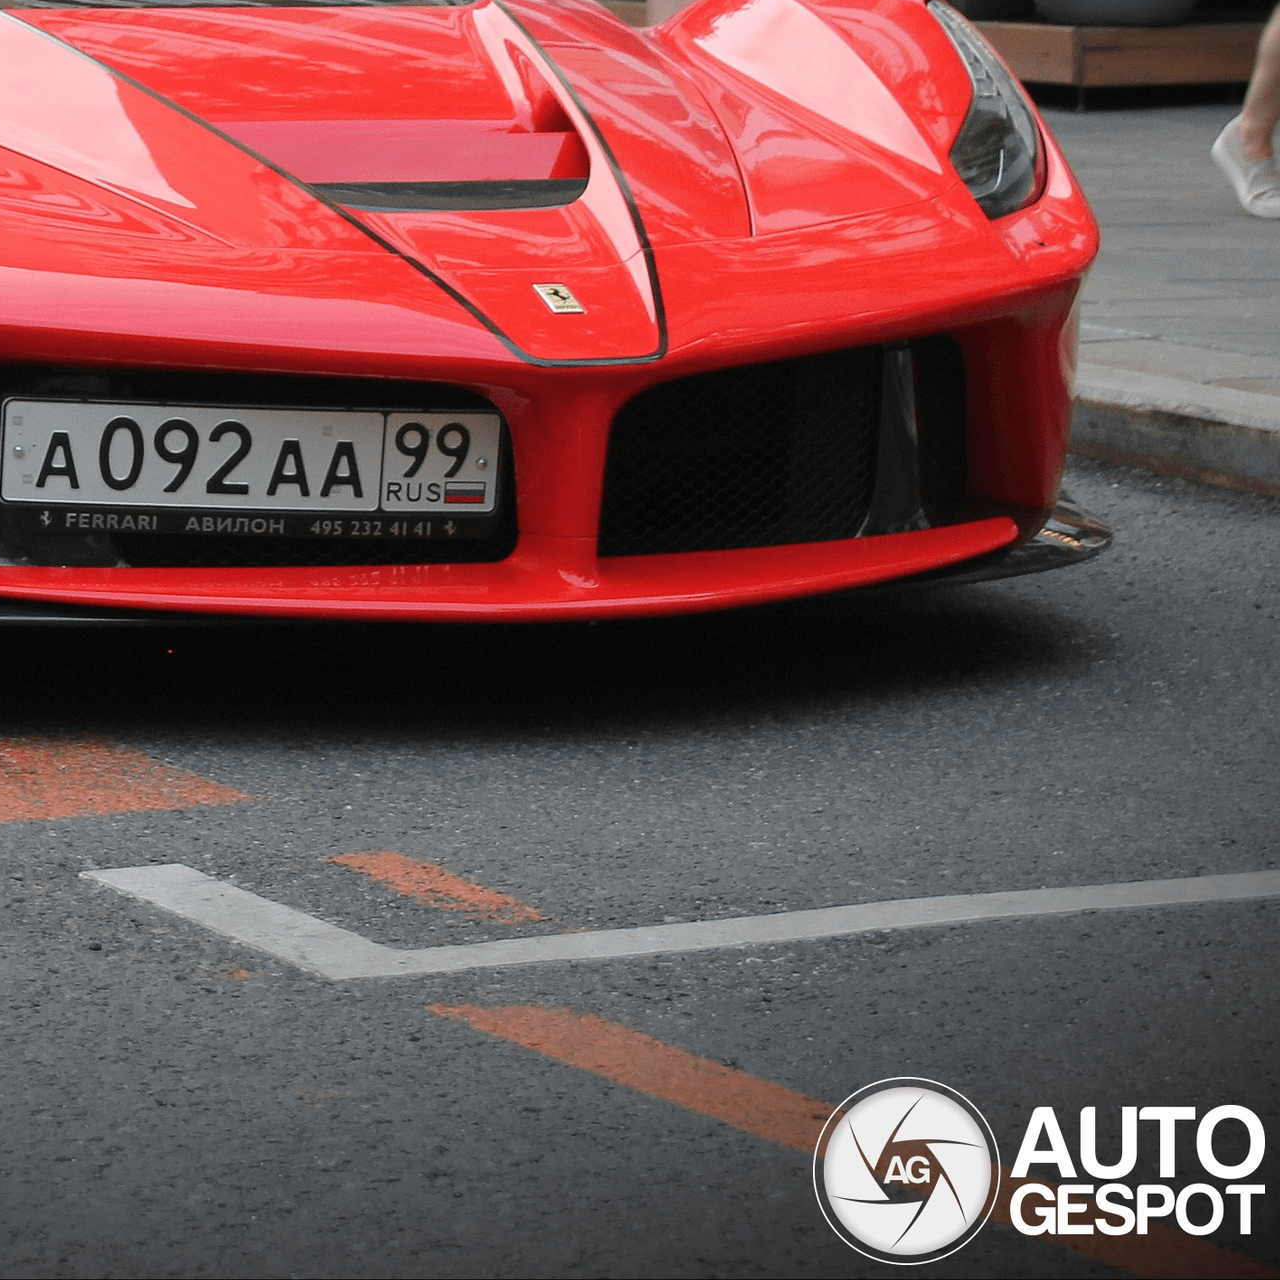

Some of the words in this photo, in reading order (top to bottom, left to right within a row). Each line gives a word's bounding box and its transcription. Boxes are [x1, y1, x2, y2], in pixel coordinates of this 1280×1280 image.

[395, 422, 470, 478] 99
[386, 481, 441, 502] RUS
[65, 513, 158, 531] FERRARI
[185, 516, 285, 534] АВИЛОН
[310, 520, 343, 535] 495
[350, 521, 382, 537] 232
[389, 521, 408, 537] 41
[413, 522, 432, 537] 41
